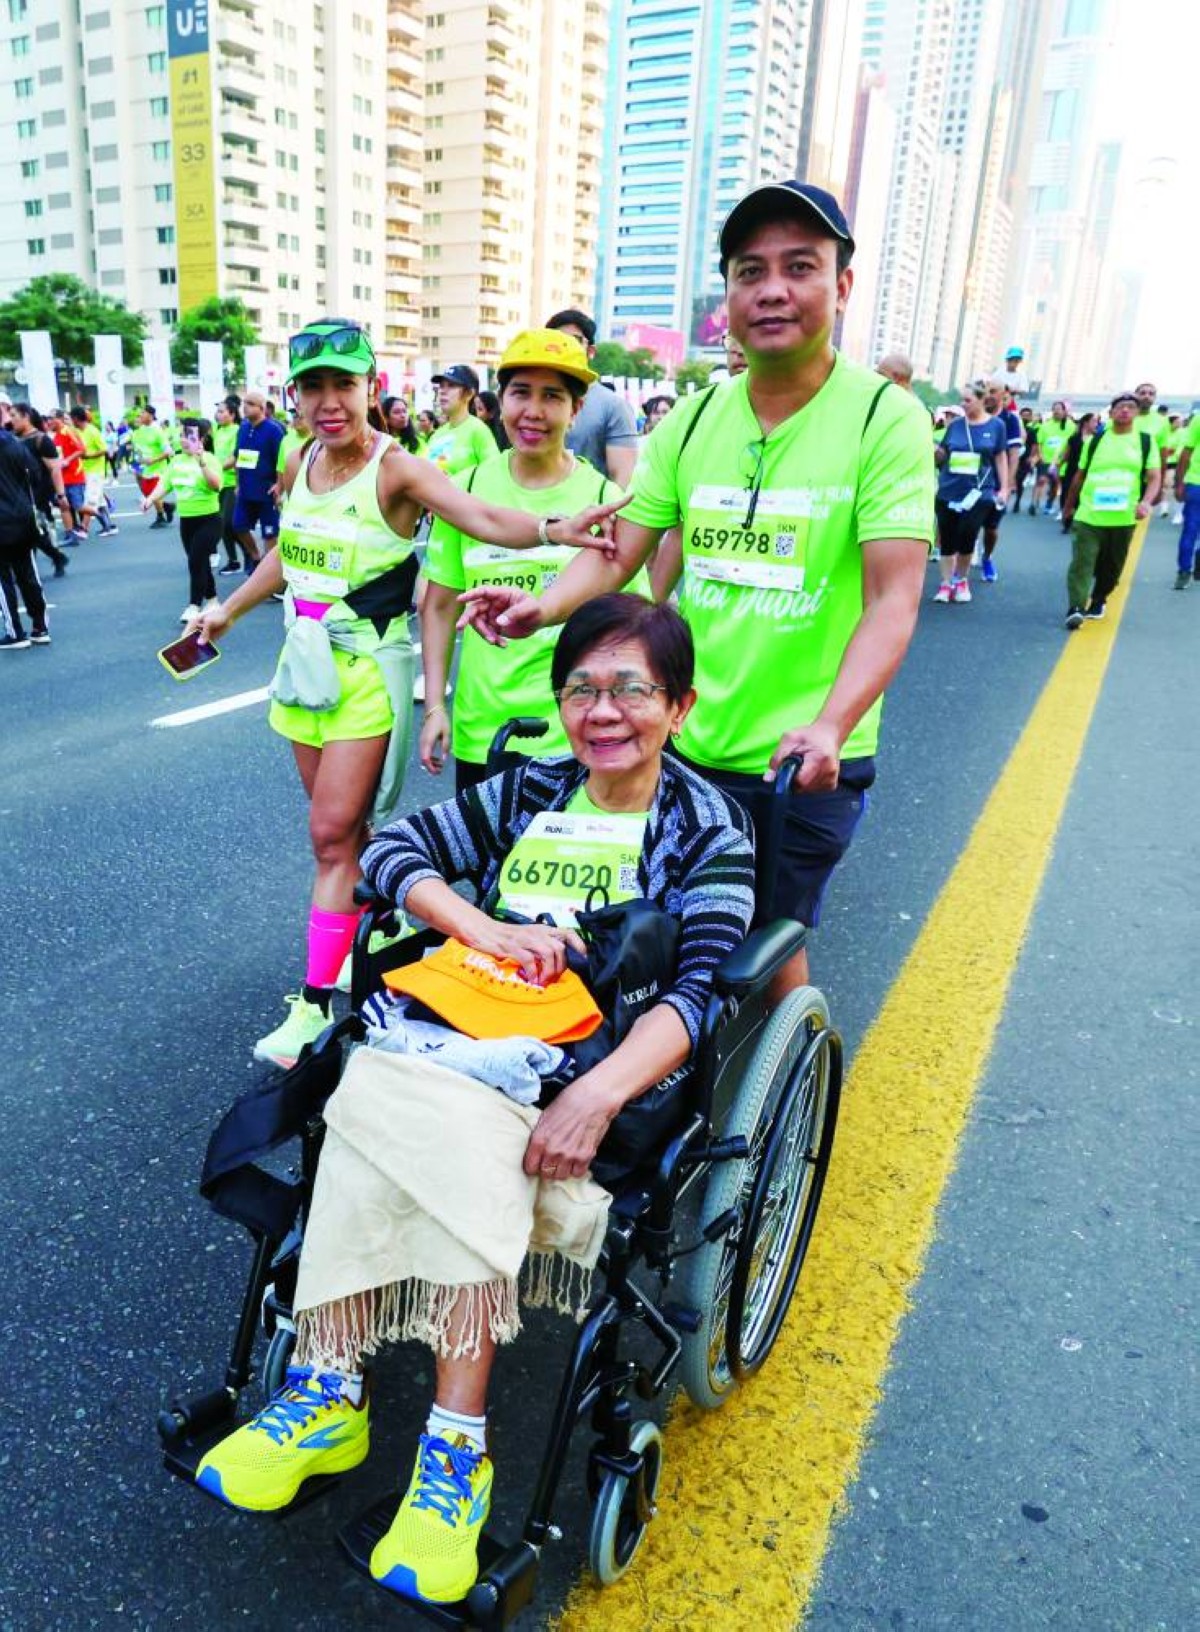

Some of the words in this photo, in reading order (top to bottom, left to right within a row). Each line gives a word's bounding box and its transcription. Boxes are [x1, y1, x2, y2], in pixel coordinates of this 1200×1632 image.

[182, 69, 198, 85] #1
[181, 142, 206, 163] 33
[691, 527, 770, 554] 659798
[282, 541, 325, 568] 667018
[472, 574, 537, 591] 799
[620, 853, 640, 865] 5K
[507, 859, 612, 889] 667020
